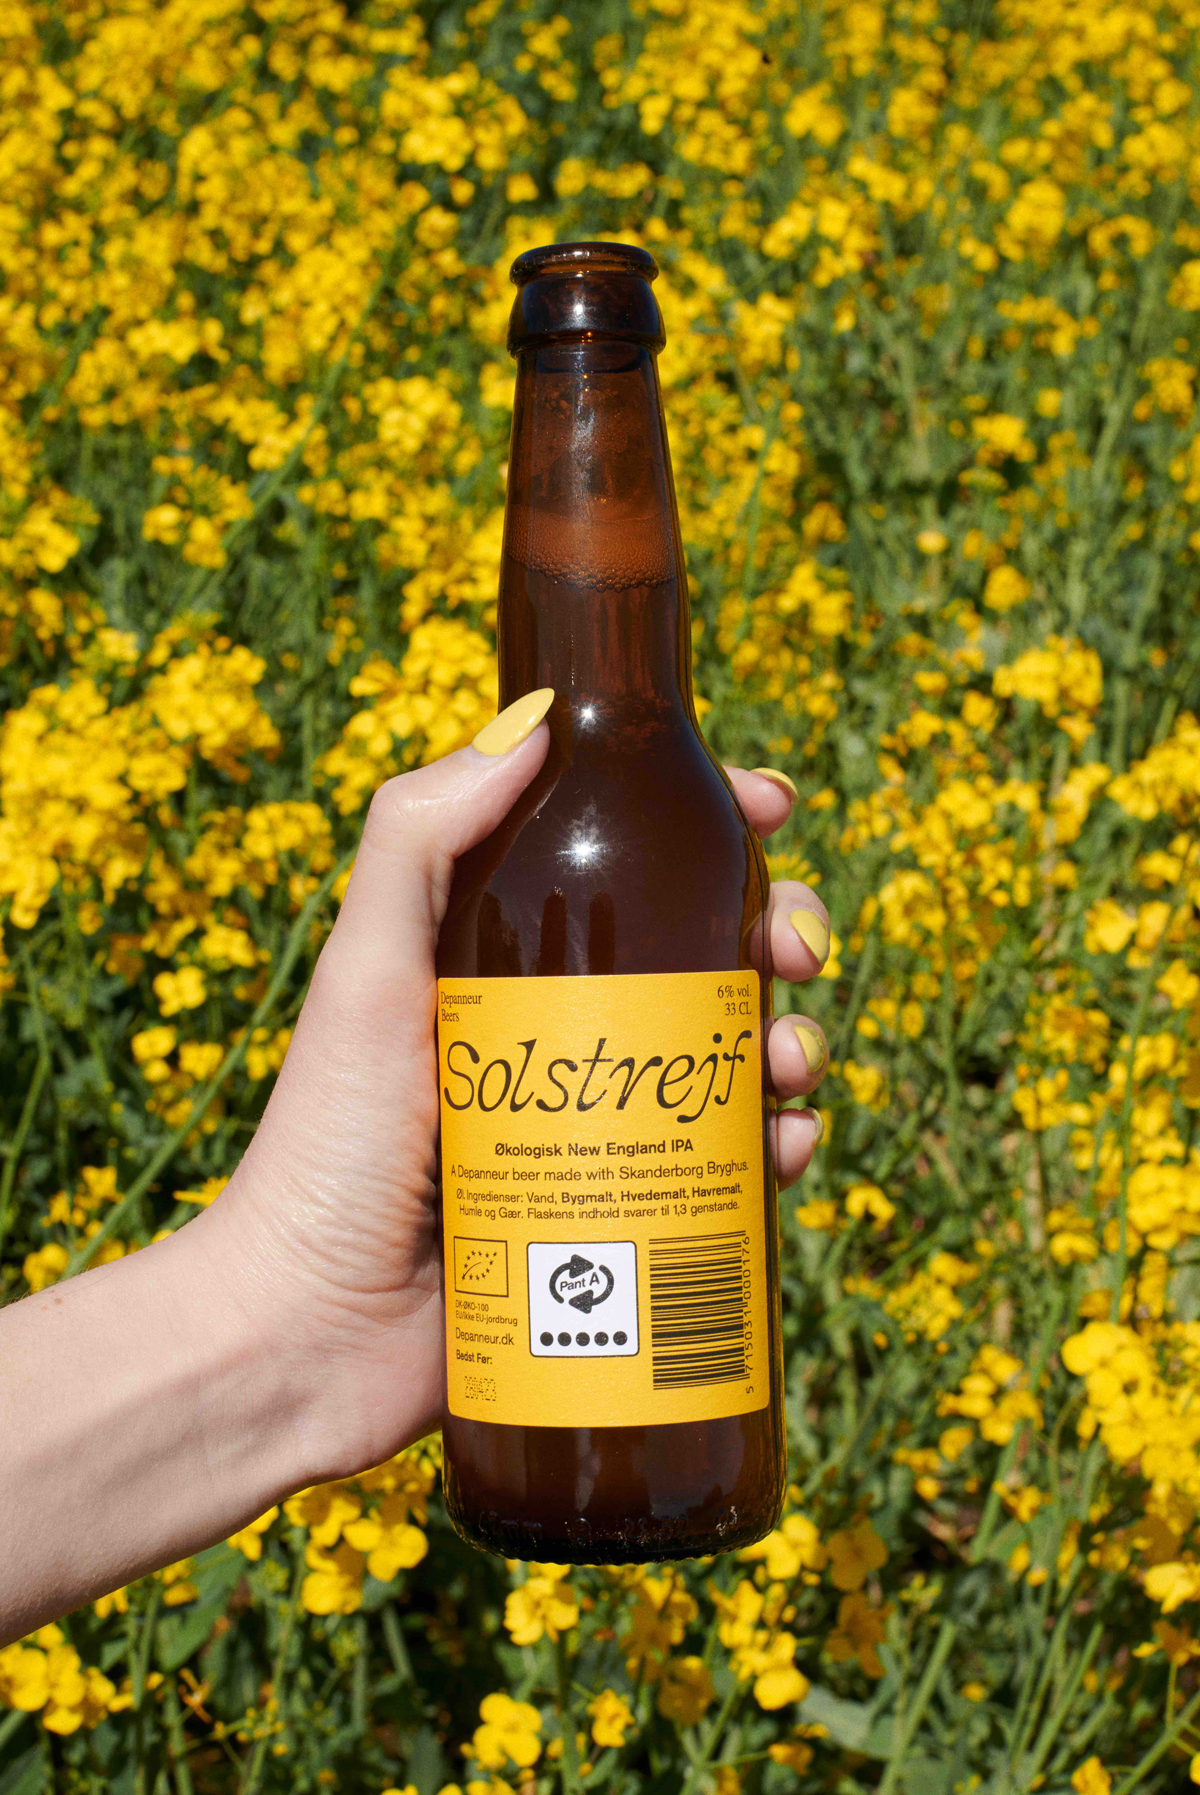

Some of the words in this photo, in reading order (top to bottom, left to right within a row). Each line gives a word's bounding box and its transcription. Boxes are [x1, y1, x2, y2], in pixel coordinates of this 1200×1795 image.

[441, 991, 482, 1008] Depanneur
[717, 984, 735, 999] 6%
[737, 984, 752, 998] vol.
[441, 1008, 460, 1022] Beers
[725, 1002, 736, 1016] 33
[739, 1001, 752, 1015] CL
[444, 1029, 753, 1123] Solstrejf
[495, 1142, 563, 1159] Økologisk
[567, 1143, 601, 1156] New
[606, 1140, 666, 1157] England
[671, 1138, 694, 1153] IPA
[451, 1164, 456, 1177] A
[458, 1165, 509, 1181] Depanneur
[512, 1167, 540, 1181] beer
[544, 1168, 582, 1181] made
[586, 1166, 614, 1180] with
[619, 1163, 703, 1179] Skanderborg
[707, 1159, 749, 1177] Bryghus.
[466, 1189, 524, 1204] Ingredienser:
[526, 1191, 558, 1205] Vand,
[561, 1191, 617, 1205] Bygmalt,
[620, 1188, 690, 1202] Hvedemalt,
[692, 1183, 743, 1198] Havremalt,
[459, 1204, 482, 1217] Humle
[484, 1208, 496, 1220] og
[499, 1206, 524, 1219] Gær.
[527, 1207, 575, 1220] Flaskens
[578, 1207, 620, 1219] indhold
[623, 1207, 657, 1217] svarer
[661, 1204, 670, 1216] til
[673, 1204, 687, 1217] 1,3
[691, 1199, 740, 1216] genstande.
[742, 1236, 752, 1300] 000176
[560, 1277, 586, 1292] Pant
[589, 1271, 600, 1286] A
[475, 1313, 518, 1327] EU-jordbrug
[455, 1326, 515, 1346] Depanneur.dk
[744, 1310, 754, 1373] 715031
[456, 1349, 475, 1363] Bedst
[476, 1352, 493, 1365] Før:
[746, 1385, 754, 1394] 5
